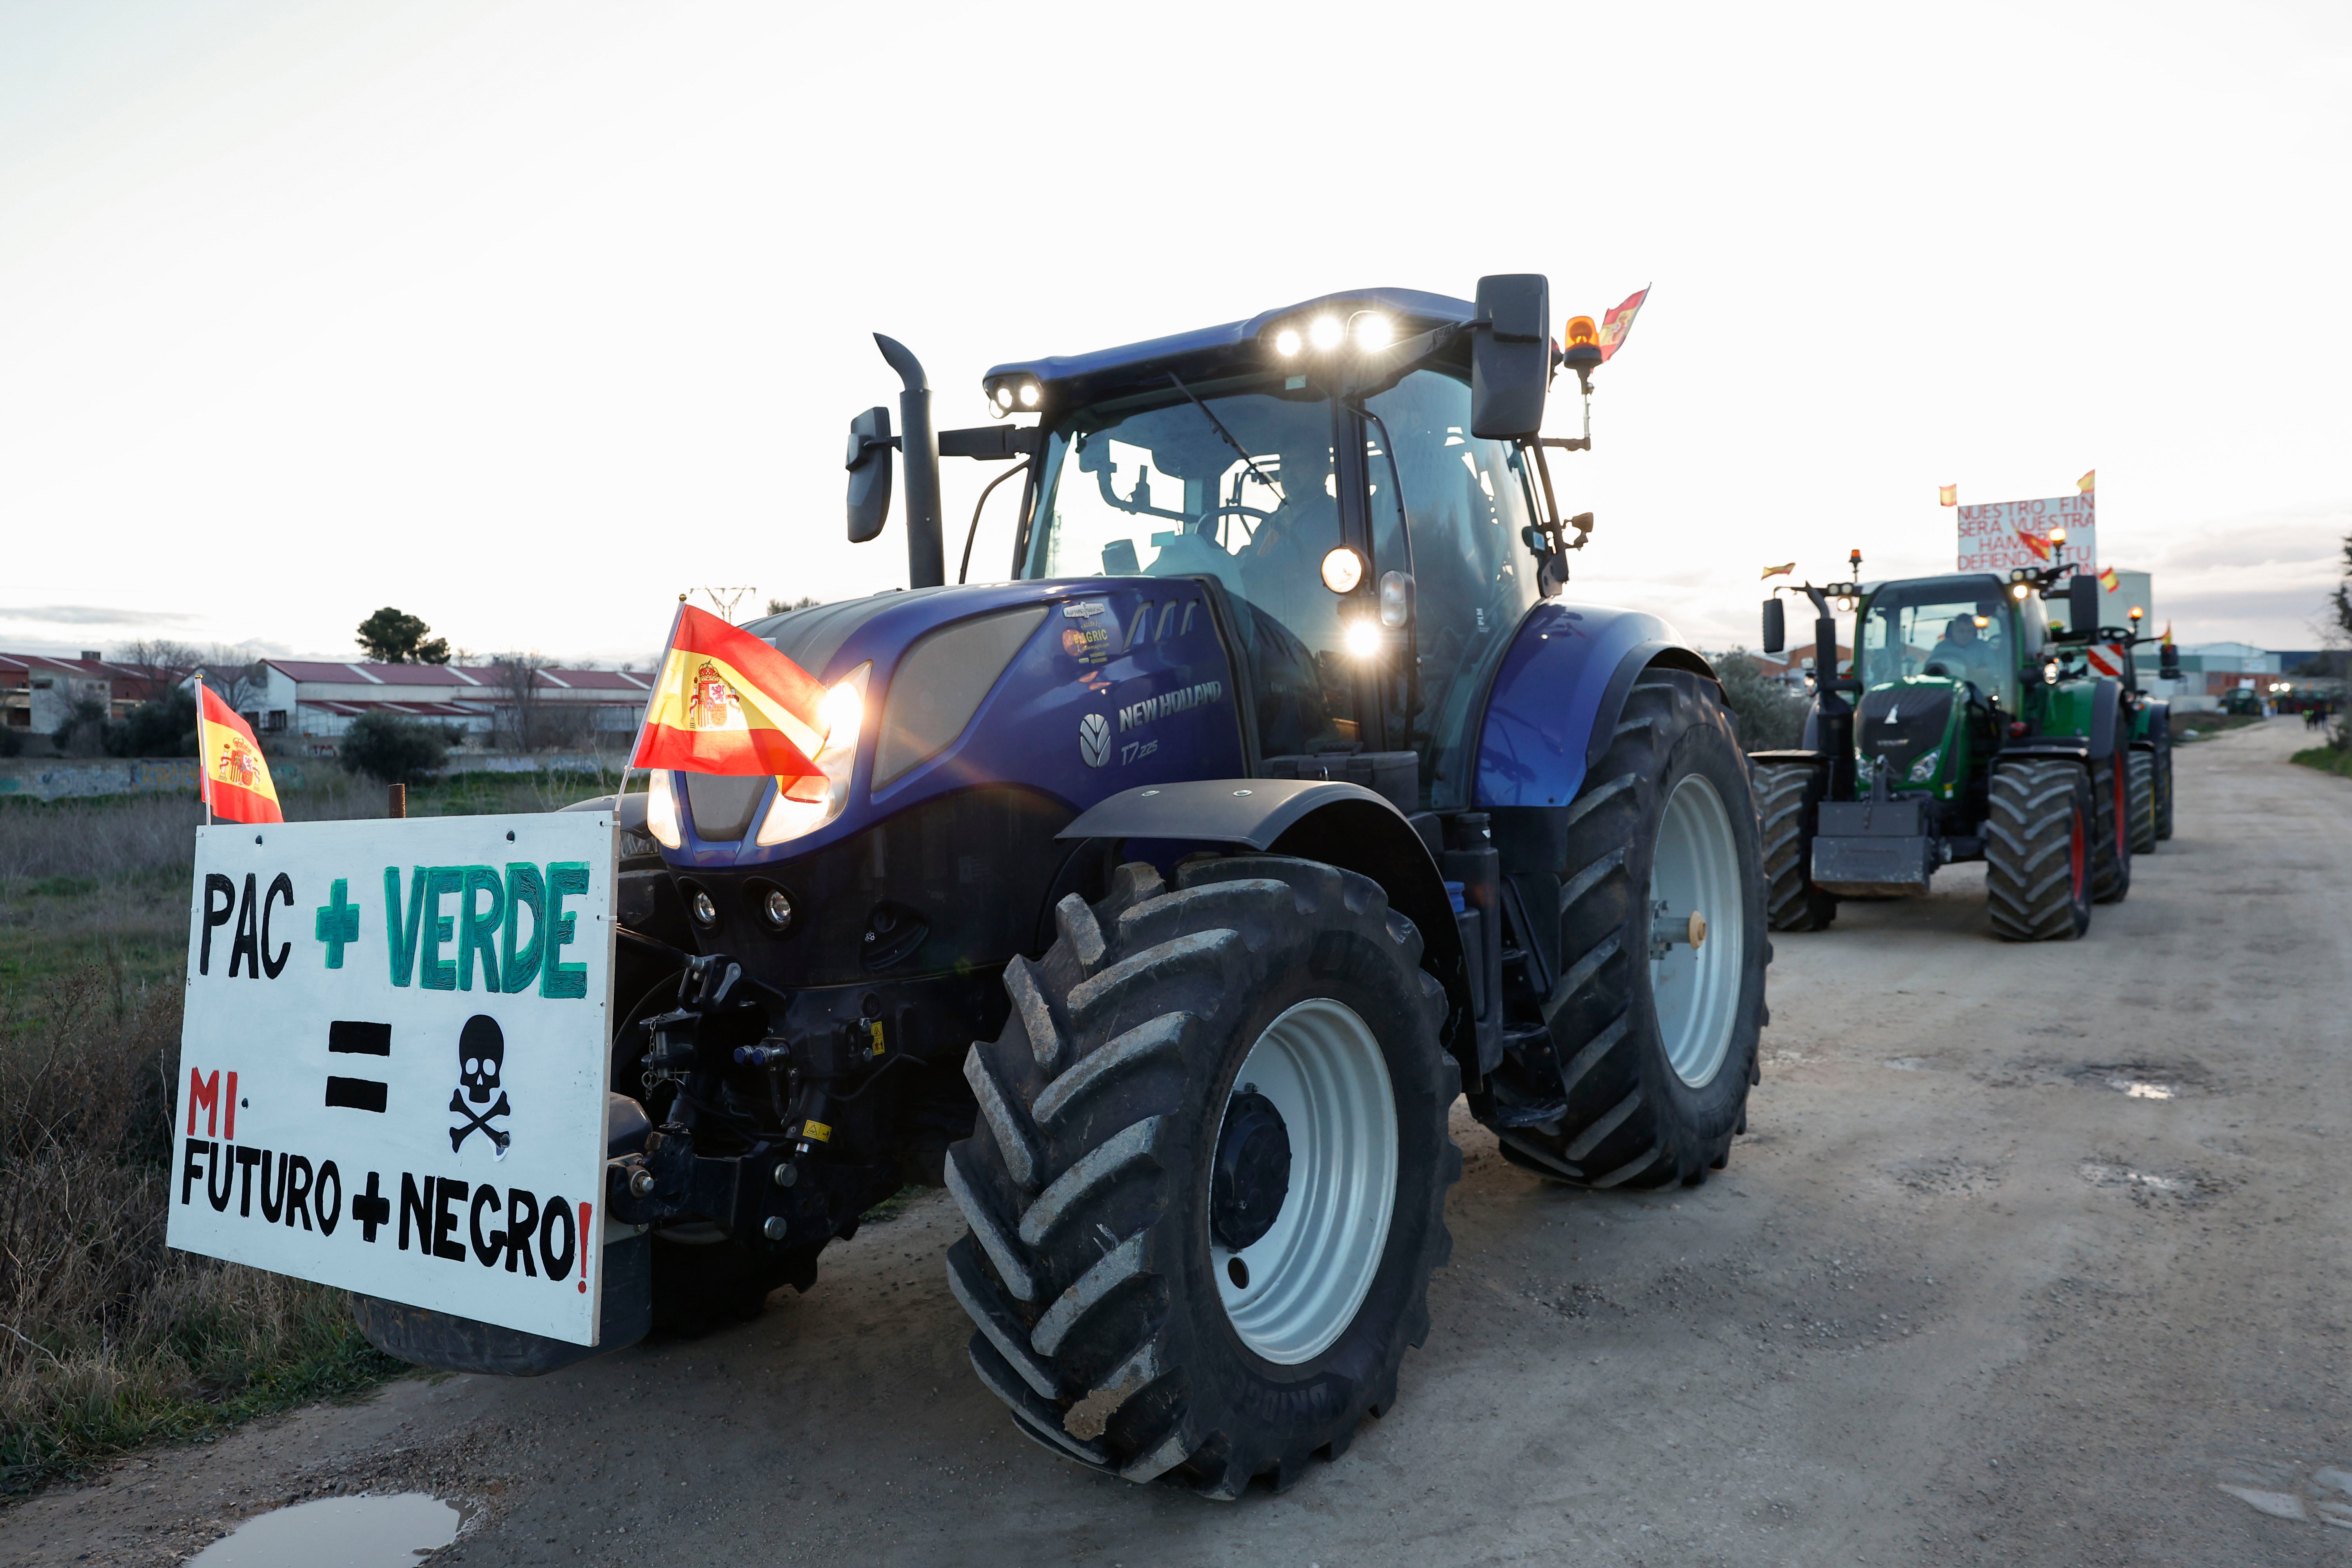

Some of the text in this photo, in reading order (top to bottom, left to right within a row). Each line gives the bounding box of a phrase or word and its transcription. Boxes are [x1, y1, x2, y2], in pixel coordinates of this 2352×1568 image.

[1958, 494, 2094, 521] NUESTRO FIN
[1959, 512, 2094, 538] SERA VUESTRA
[2063, 545, 2092, 562] TU
[1118, 681, 1222, 733] NEW HOLLAND
[200, 861, 590, 999] PAC + VERDE
[187, 1067, 237, 1140] MI
[182, 1138, 341, 1237] FUTURO
[399, 1172, 592, 1293] NEGRO!
